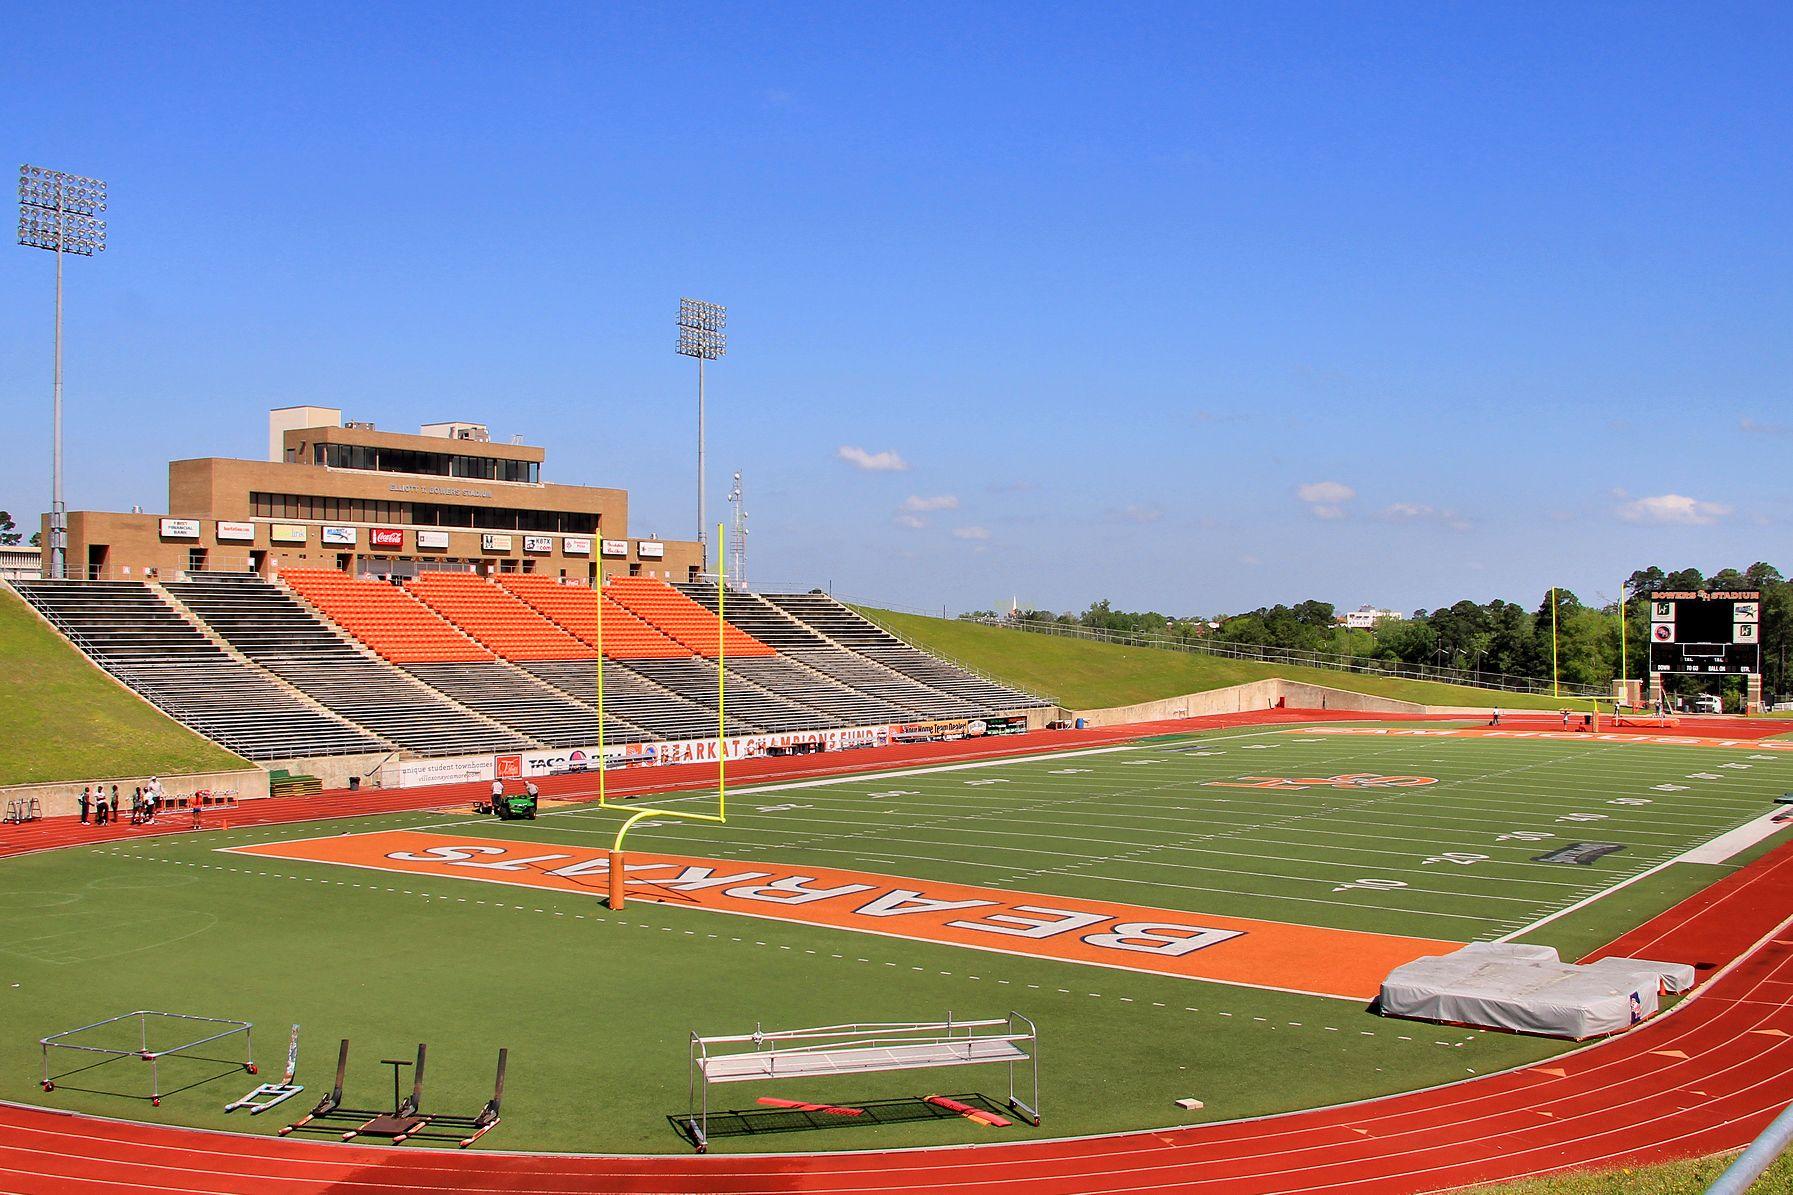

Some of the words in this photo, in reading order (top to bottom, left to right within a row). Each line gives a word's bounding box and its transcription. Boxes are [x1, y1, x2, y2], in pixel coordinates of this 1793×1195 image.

[429, 487, 460, 496] BOWERS
[462, 488, 492, 498] STADIUM
[1651, 591, 1697, 600] BOWERS
[1711, 591, 1760, 600] STADIUM
[660, 739, 740, 763] BEARKAT
[402, 767, 426, 775] unique
[427, 763, 454, 772] student
[455, 761, 493, 770] townhomes
[528, 757, 565, 769] TACO
[1426, 852, 1491, 865] 20
[1342, 878, 1409, 892] 10
[386, 845, 1248, 958] BEARKATS
